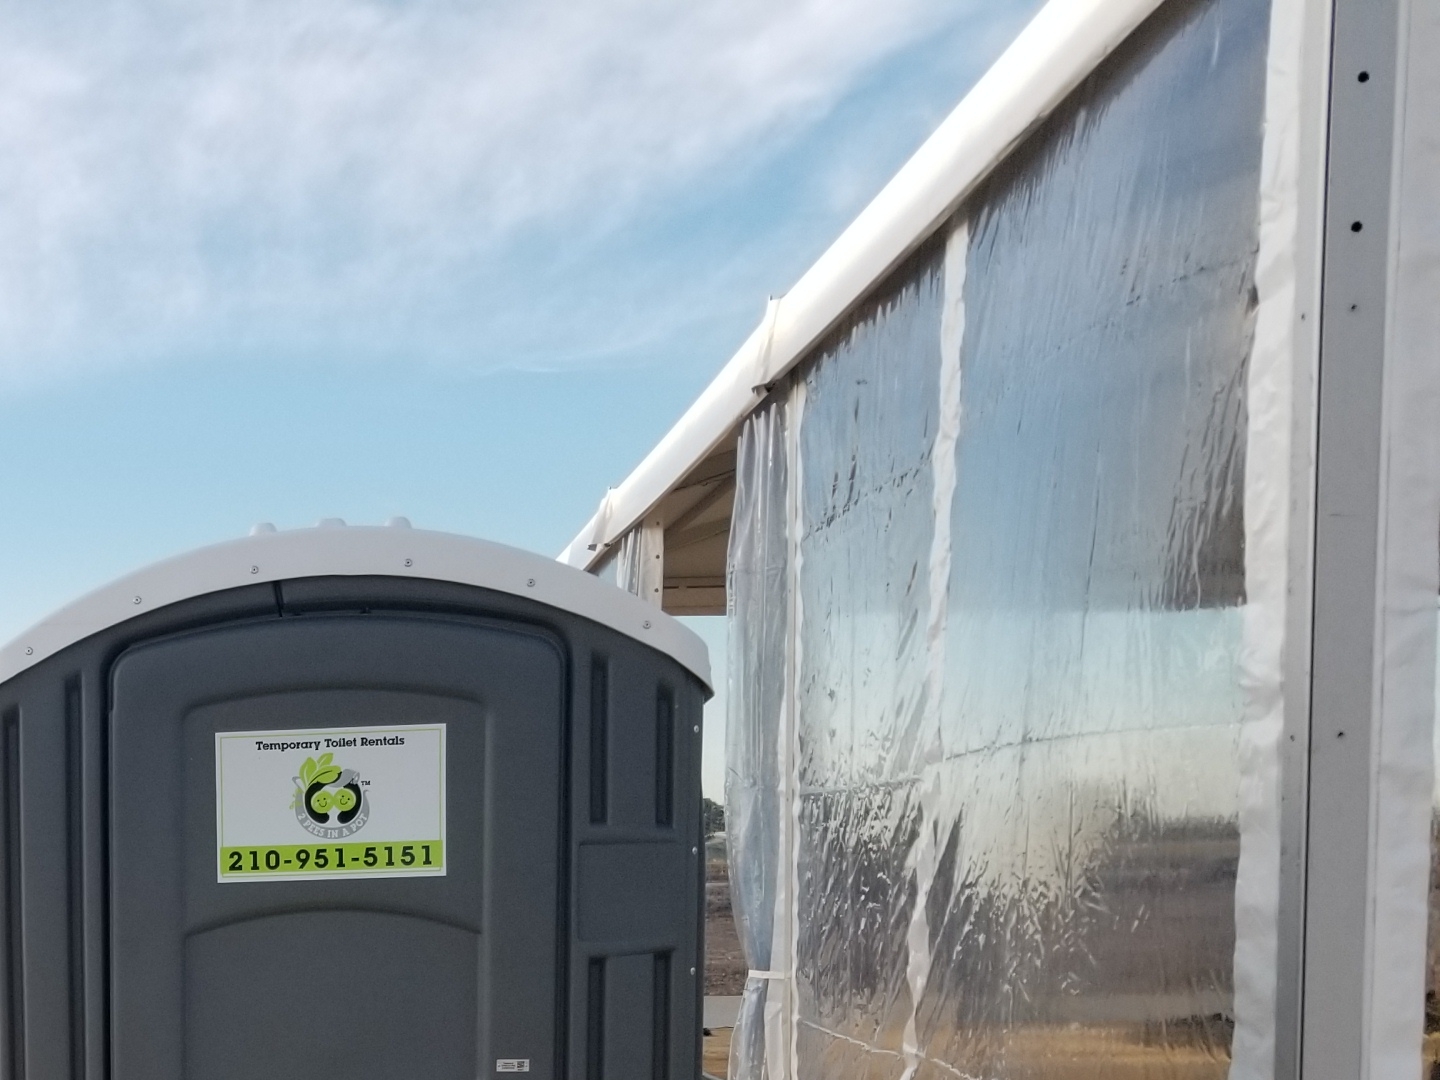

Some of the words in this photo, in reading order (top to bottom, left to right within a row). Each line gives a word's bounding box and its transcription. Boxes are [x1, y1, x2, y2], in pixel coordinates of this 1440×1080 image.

[255, 740, 321, 751] Temporary
[324, 737, 357, 748] Toilet
[360, 736, 405, 747] Rentals
[297, 812, 306, 821] 2
[303, 820, 324, 837] PEES
[327, 829, 338, 838] IN
[342, 828, 350, 837] A
[350, 813, 367, 831] POT
[228, 845, 432, 871] 210-951-5151
